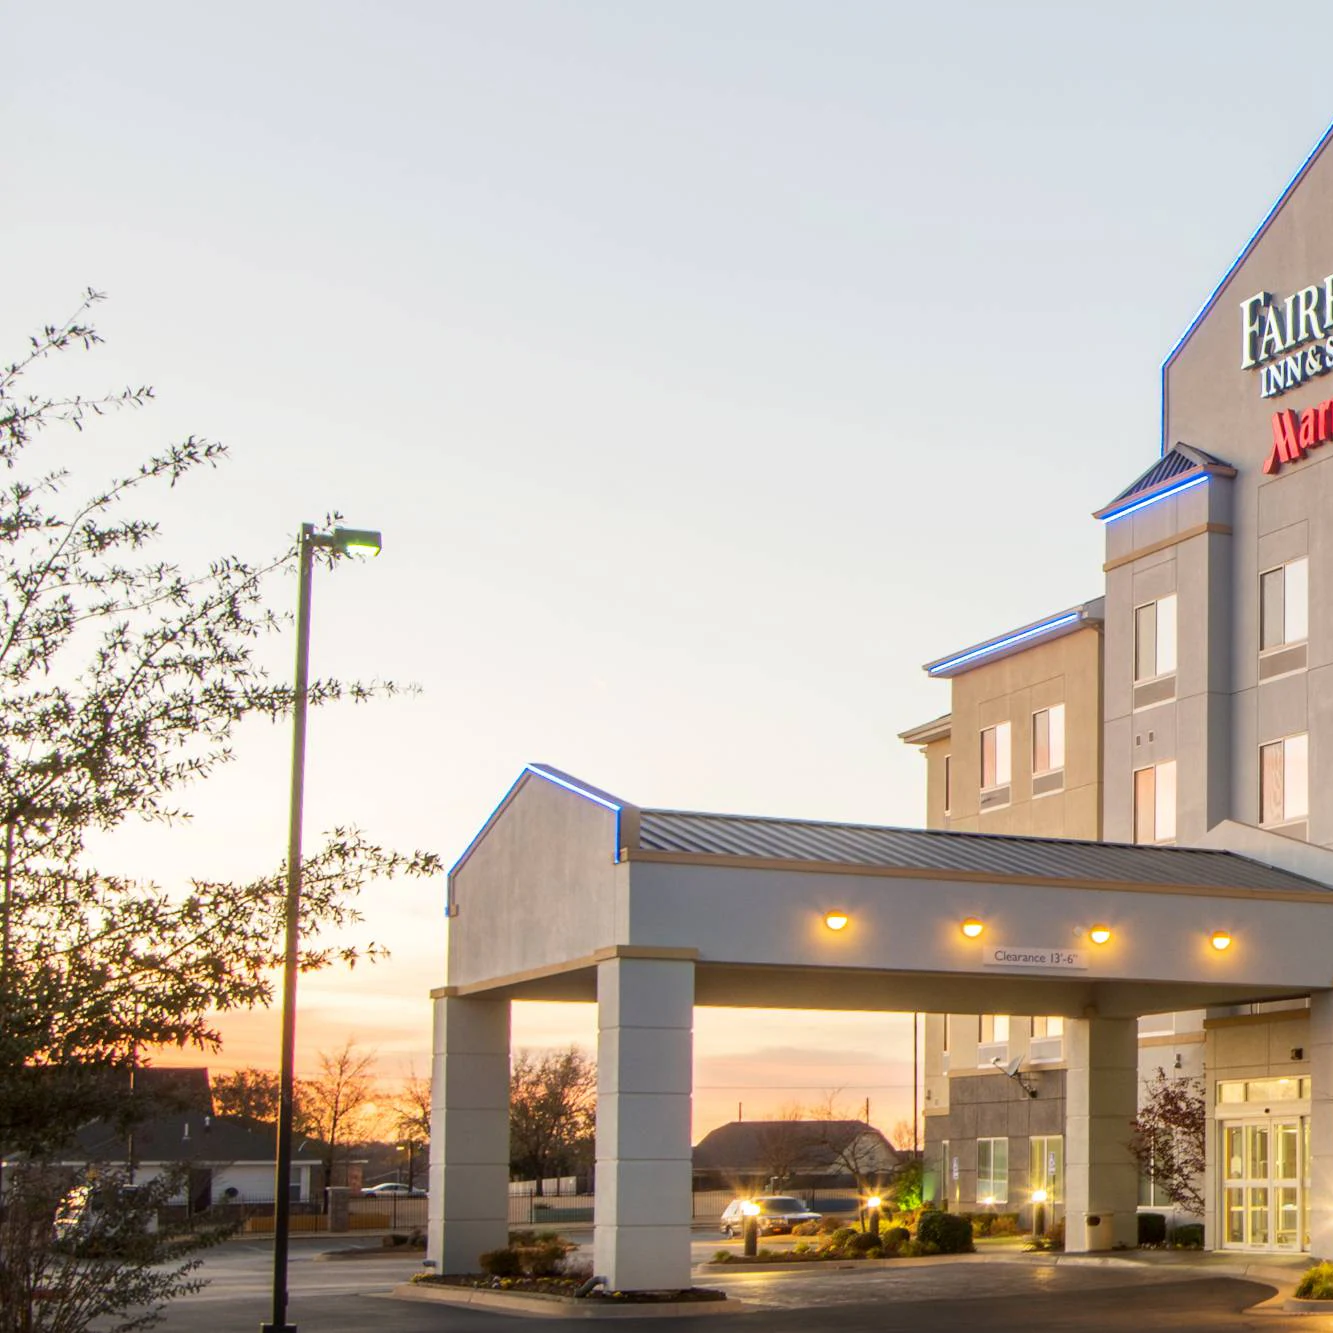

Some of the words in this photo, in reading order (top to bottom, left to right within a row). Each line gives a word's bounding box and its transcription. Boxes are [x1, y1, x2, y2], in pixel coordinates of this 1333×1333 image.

[1260, 351, 1303, 398] INN
[1305, 345, 1323, 377] &
[994, 950, 1046, 963] Clearance
